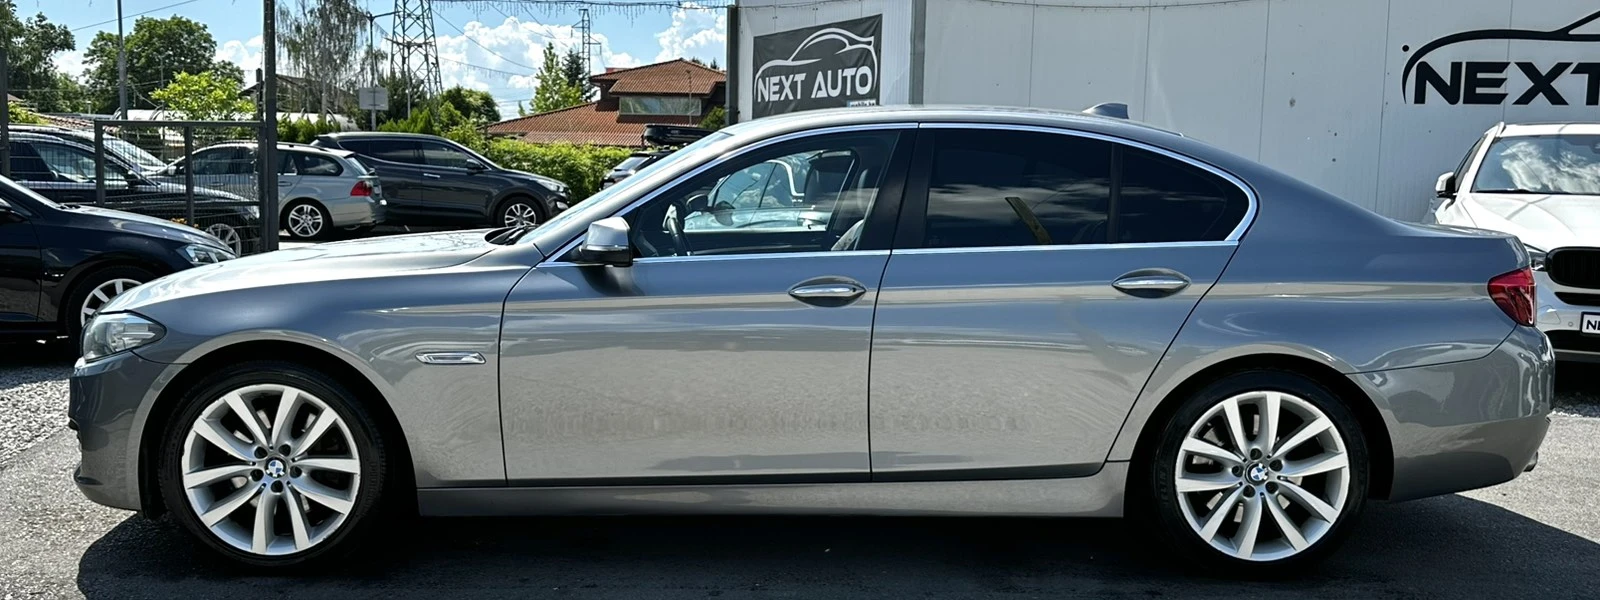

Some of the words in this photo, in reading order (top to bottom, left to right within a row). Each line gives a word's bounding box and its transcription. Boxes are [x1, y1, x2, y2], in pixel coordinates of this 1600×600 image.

[757, 73, 806, 102] NEXT
[811, 66, 872, 98] AUTO
[1414, 61, 1600, 105] NEXT
